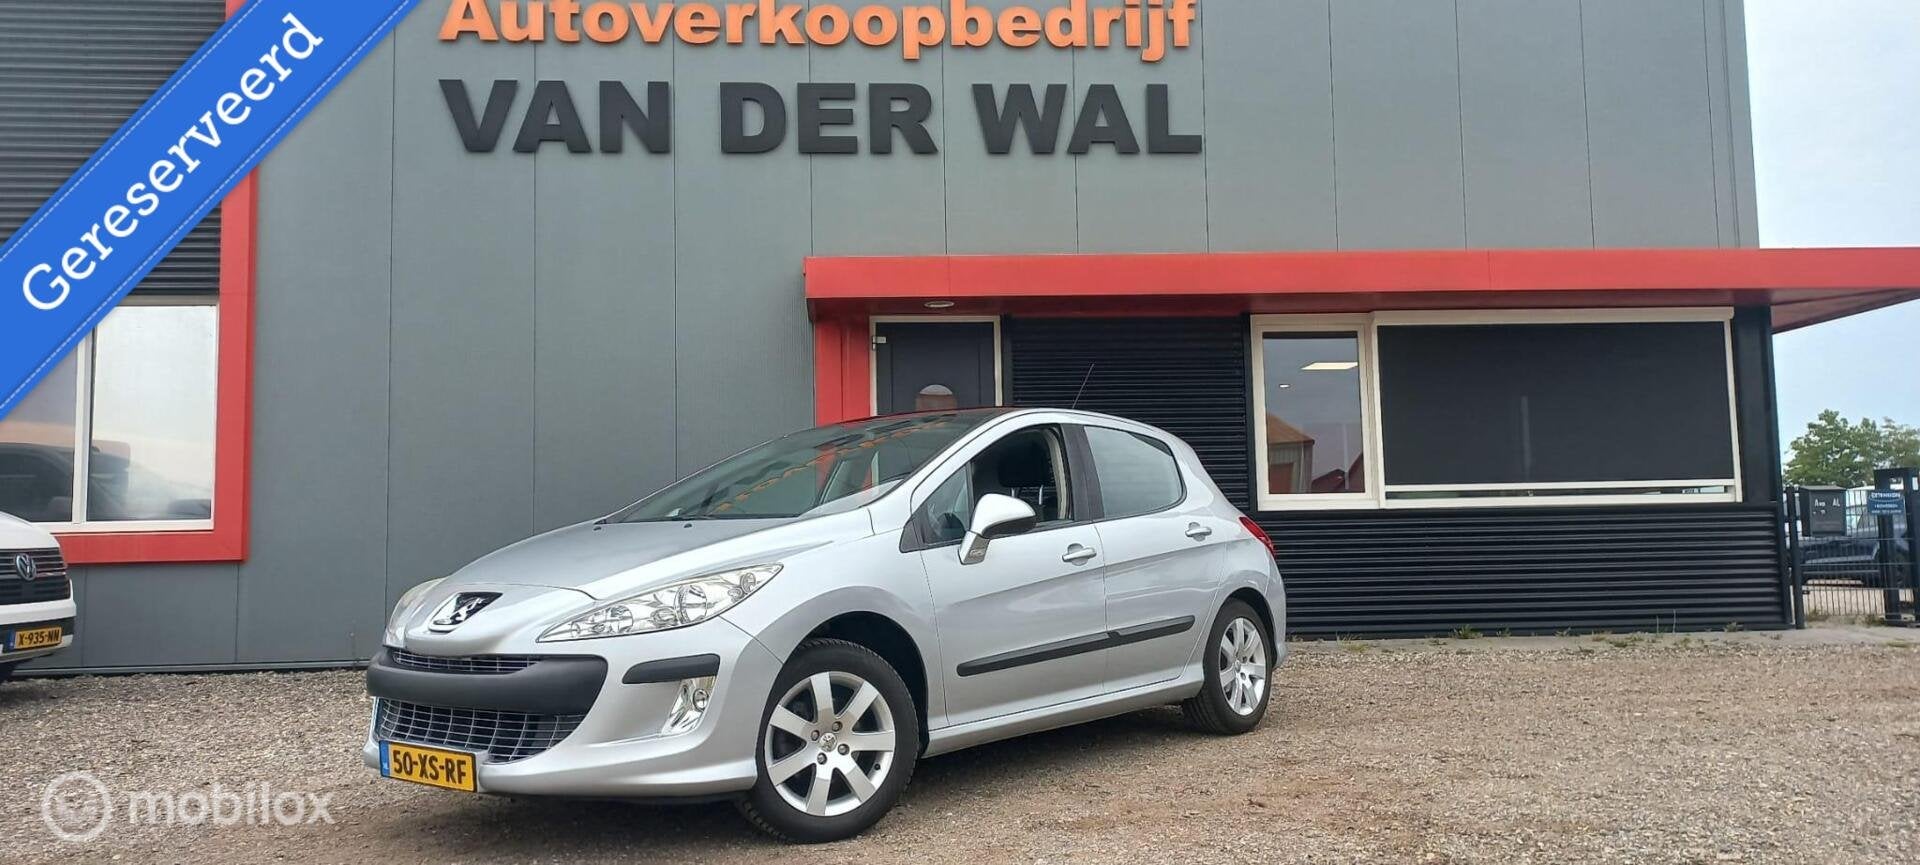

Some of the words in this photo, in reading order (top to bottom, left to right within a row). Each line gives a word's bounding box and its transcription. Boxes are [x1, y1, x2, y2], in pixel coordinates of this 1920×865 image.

[438, 0, 1196, 62] Autoverkoopbedrijf
[438, 79, 671, 153] VAN
[719, 82, 939, 154] DER
[971, 83, 1202, 154] WAL
[18, 629, 60, 646] X-935-NN
[393, 749, 467, 785] 50-XS-RF
